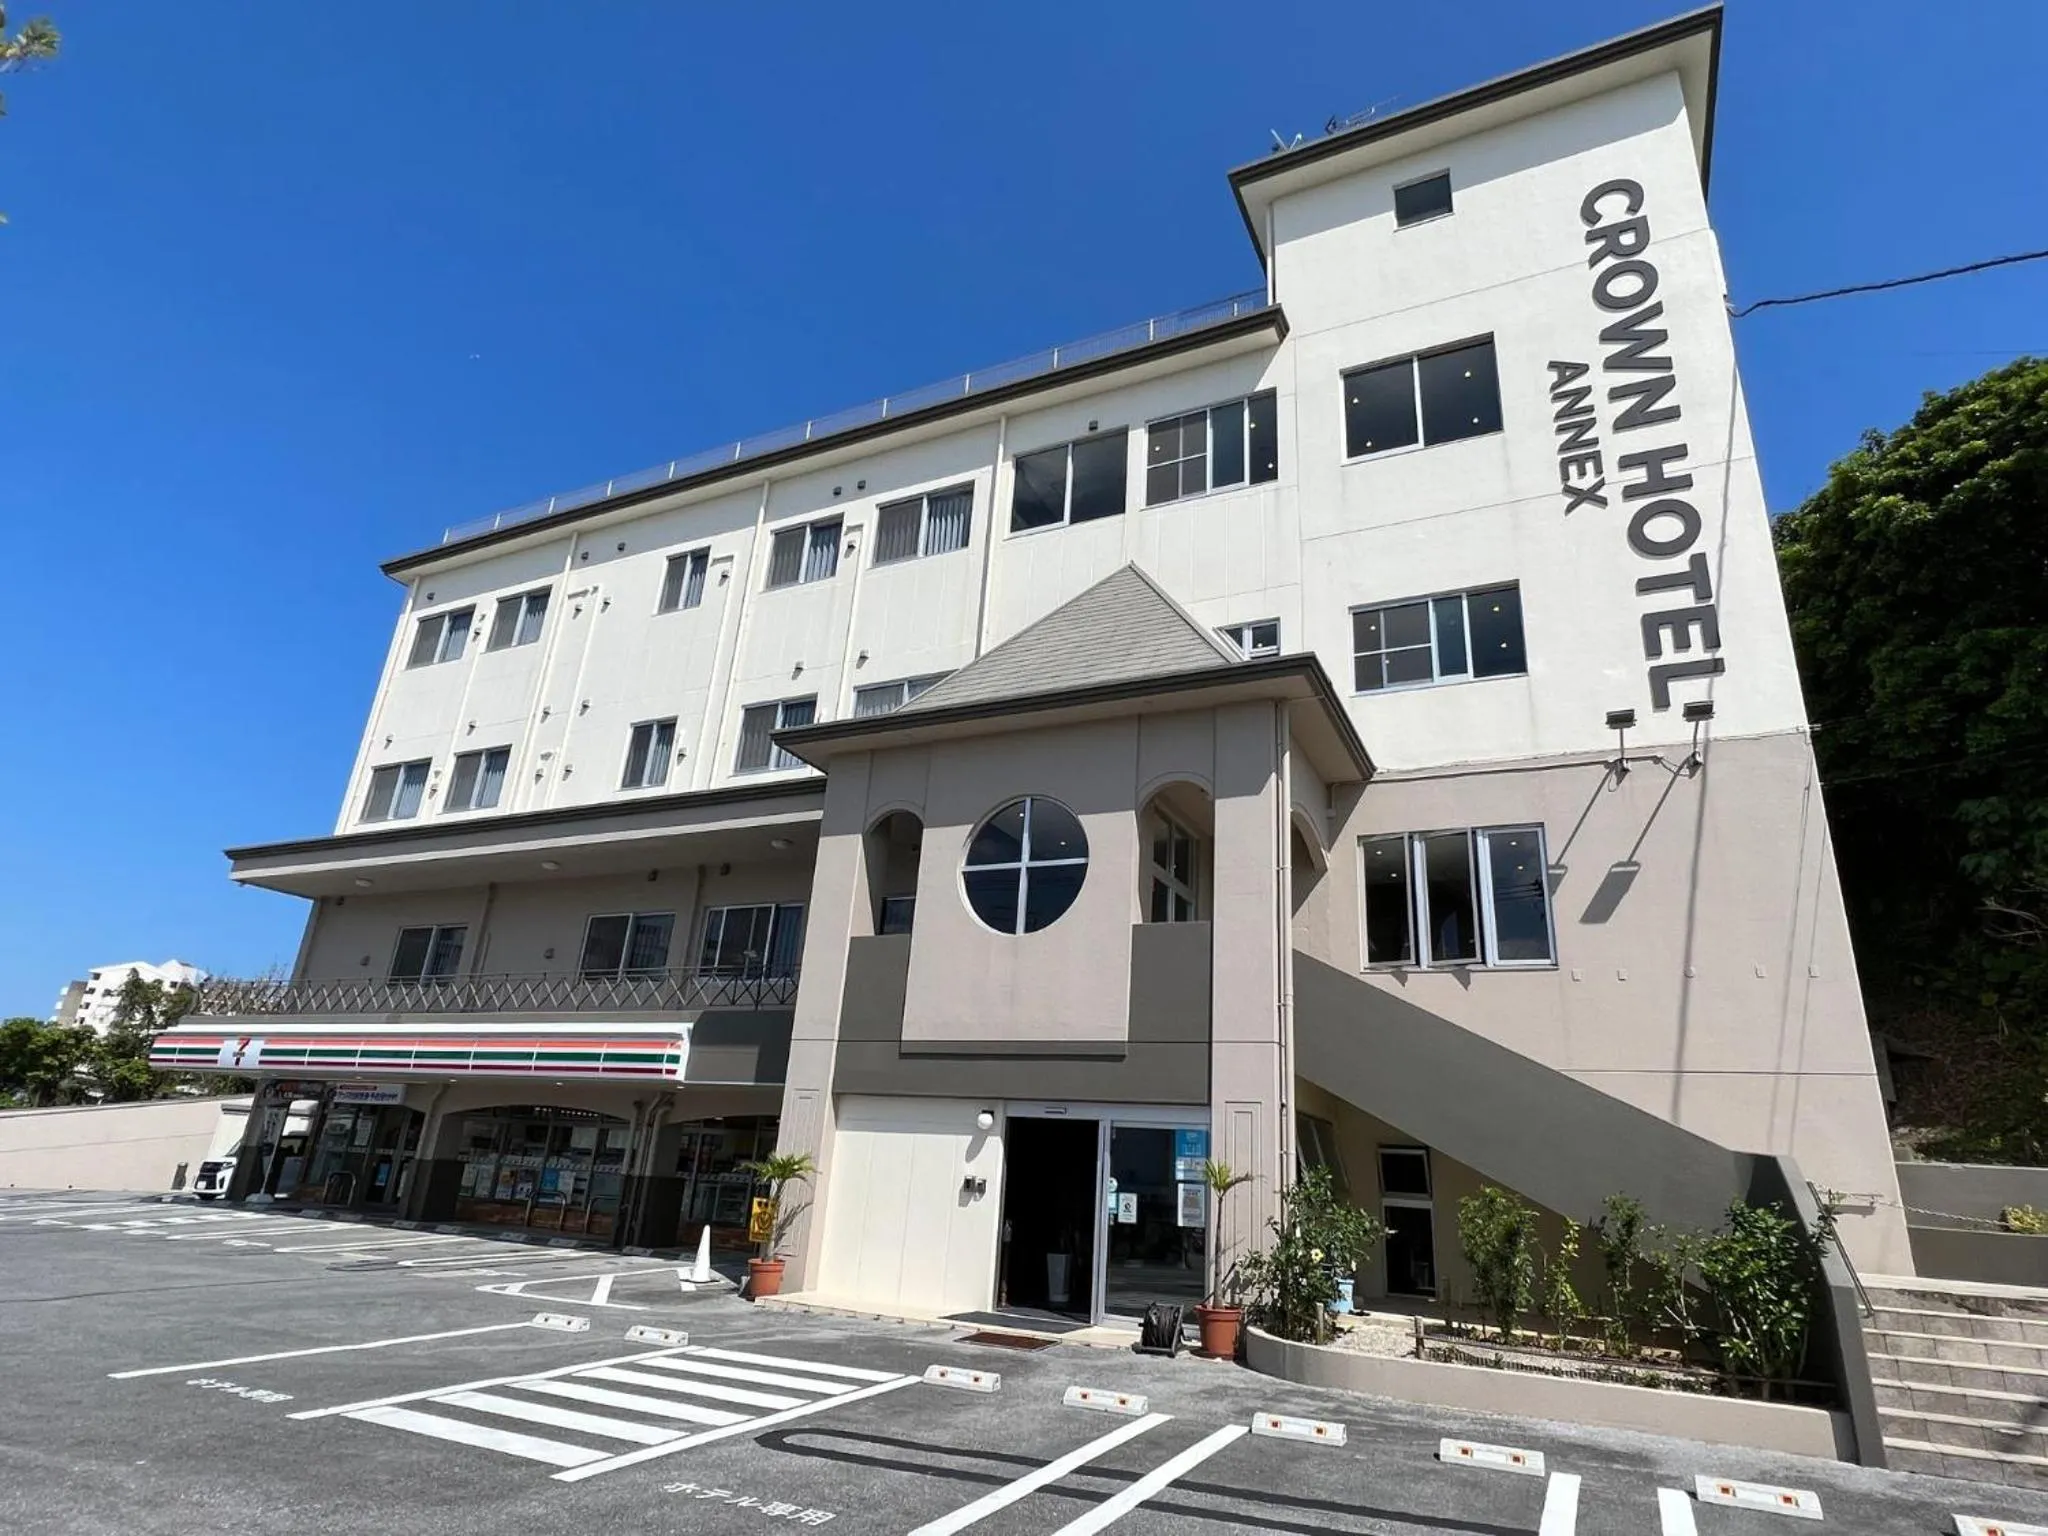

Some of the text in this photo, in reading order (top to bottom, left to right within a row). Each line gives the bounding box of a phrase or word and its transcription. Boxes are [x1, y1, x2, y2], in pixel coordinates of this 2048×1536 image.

[1547, 360, 1608, 516] ANNEX
[1580, 179, 1725, 712] CROWN HOTEL
[663, 1482, 837, 1526] ホテル専用
